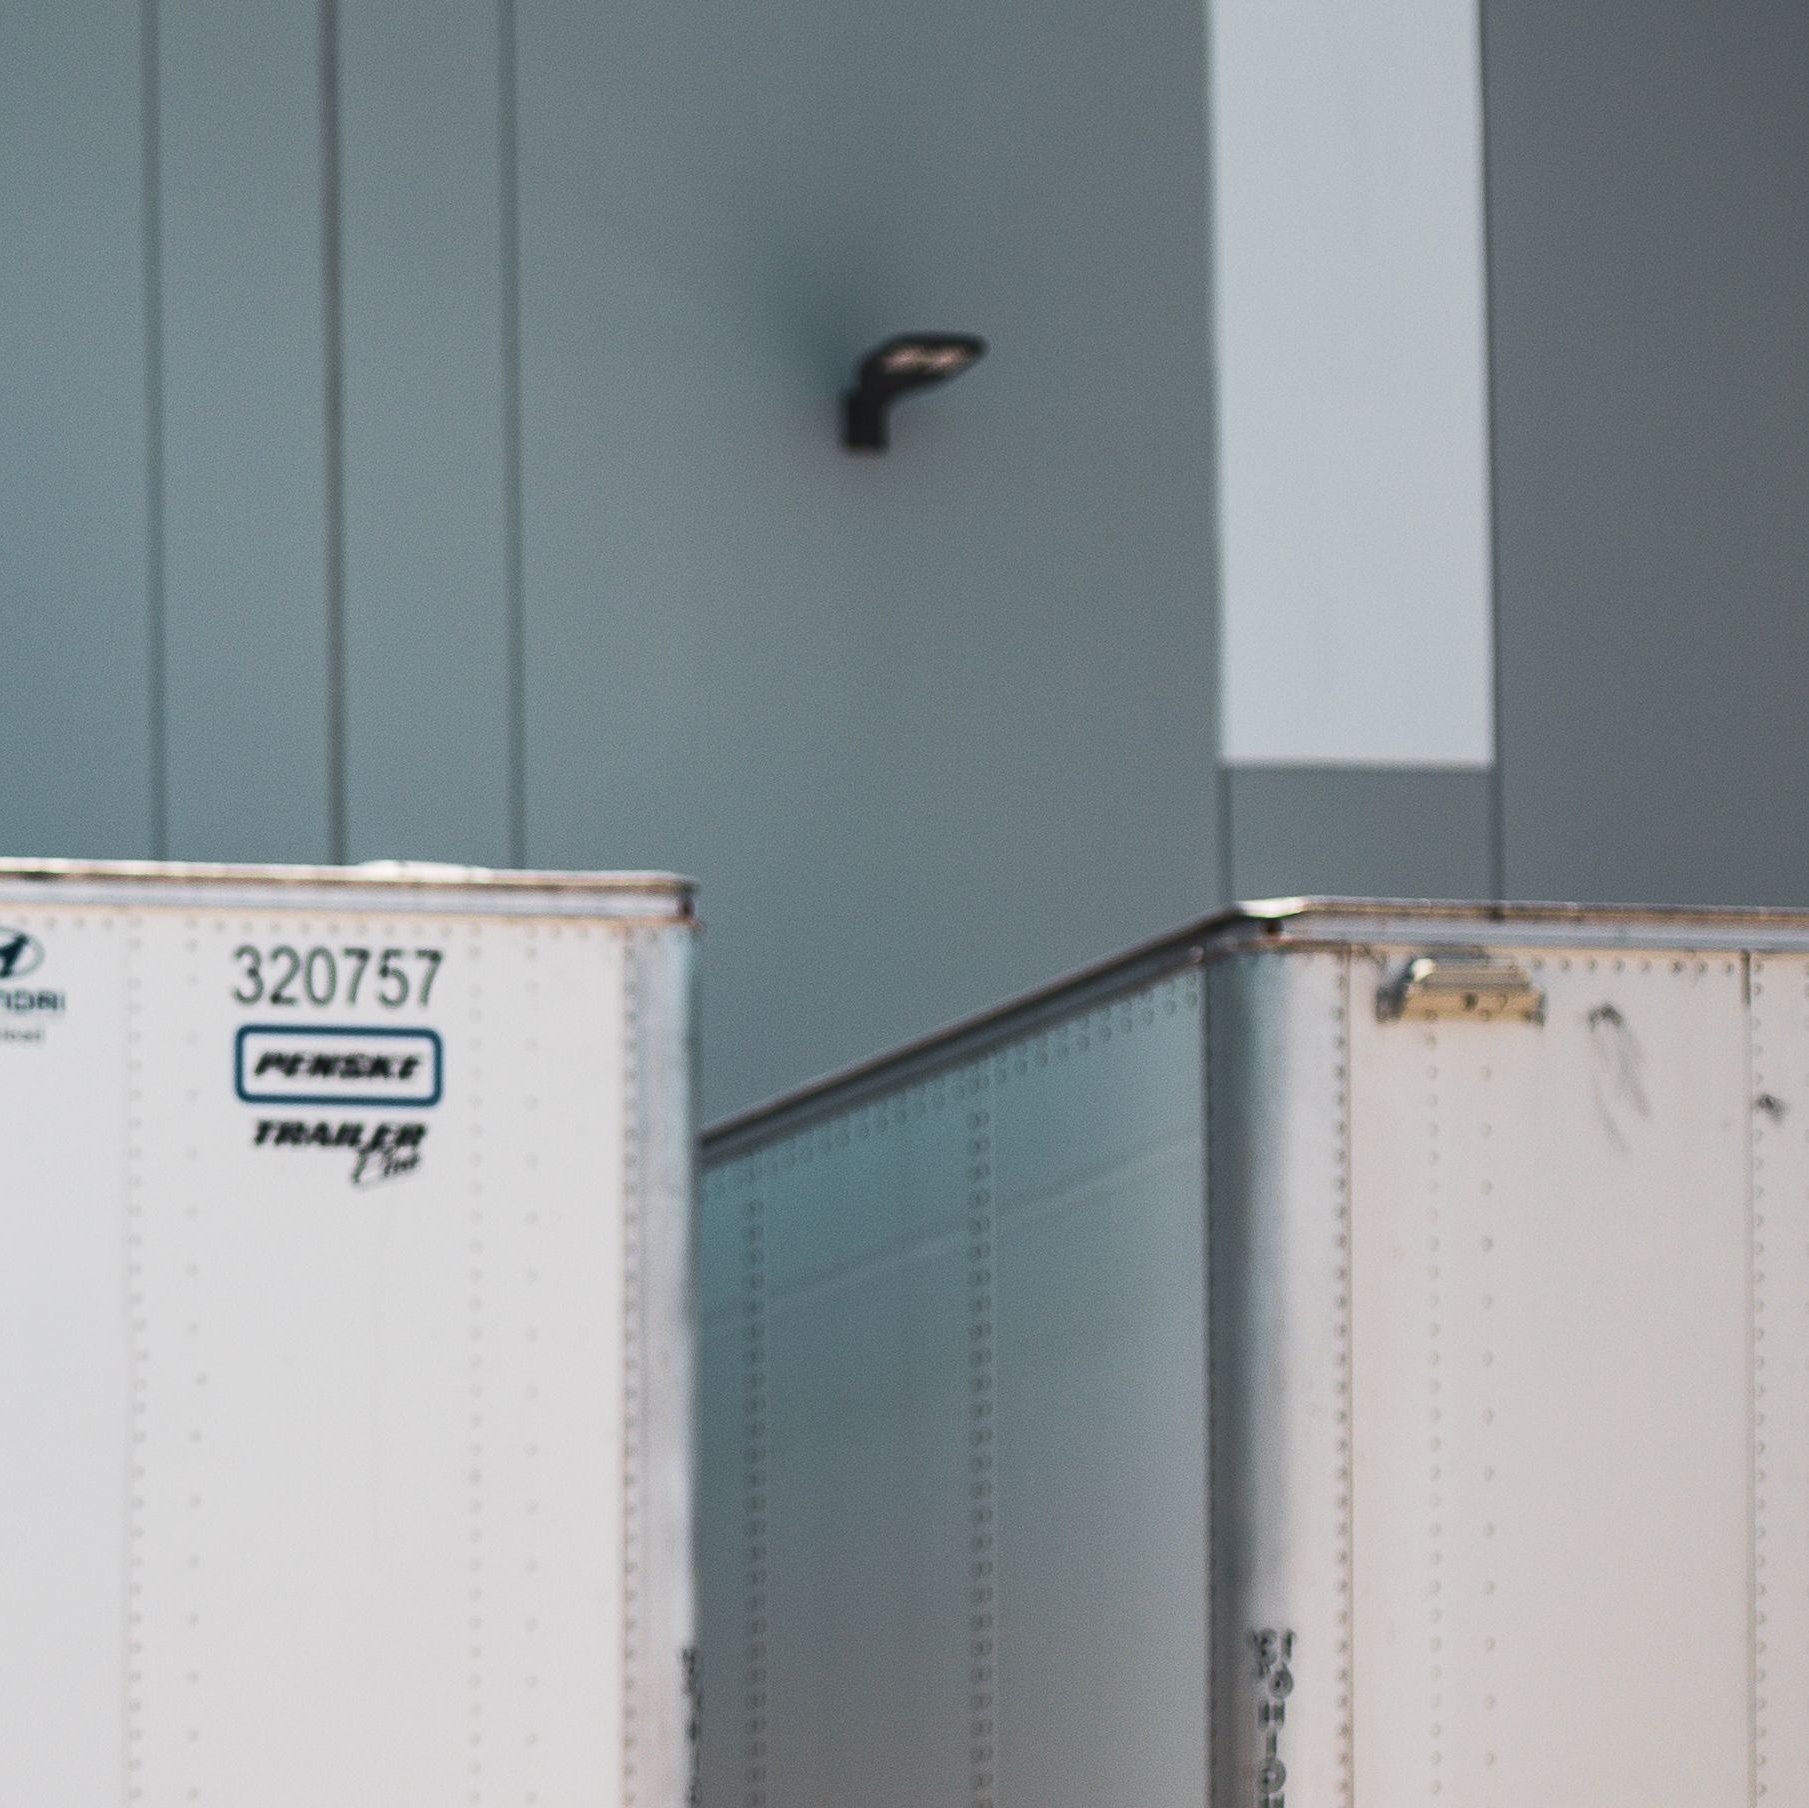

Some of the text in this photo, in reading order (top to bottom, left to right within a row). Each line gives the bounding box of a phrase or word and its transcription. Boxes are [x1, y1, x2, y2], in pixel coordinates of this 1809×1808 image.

[232, 943, 443, 1009] 320757
[254, 1051, 421, 1080] PENSKE
[252, 1118, 428, 1149] TRAILER
